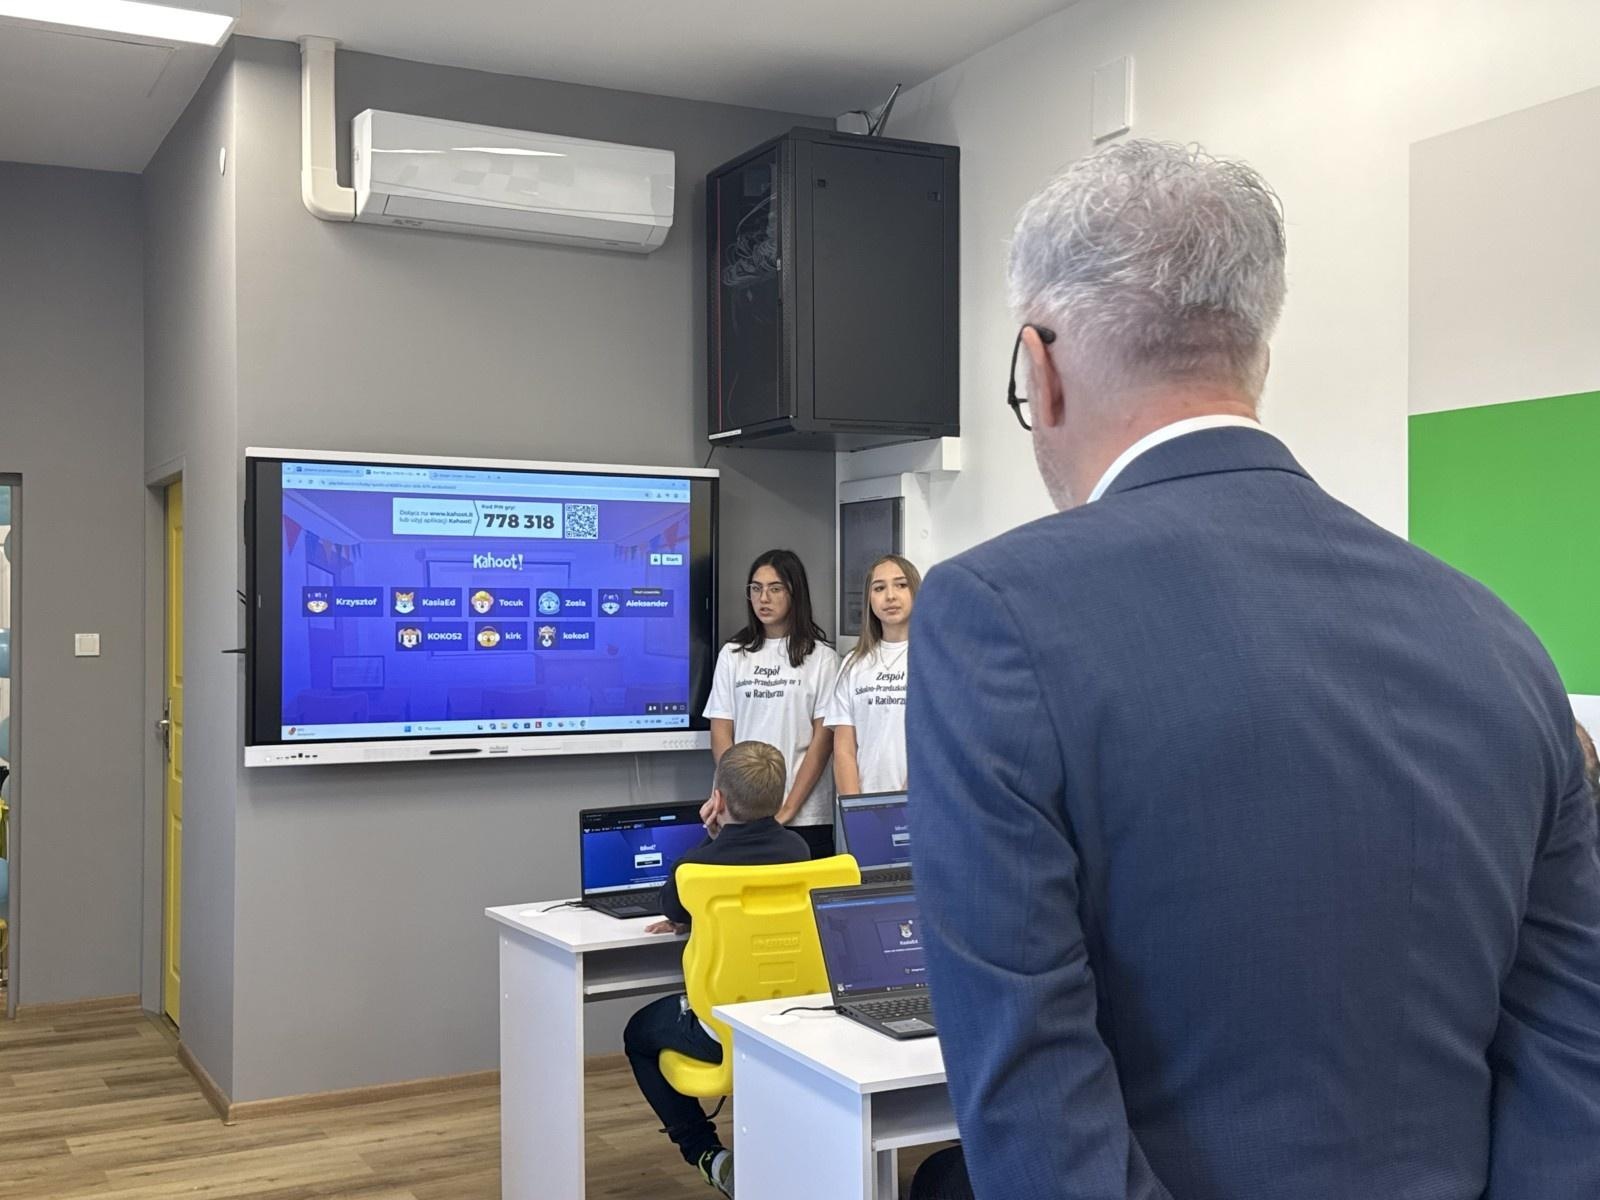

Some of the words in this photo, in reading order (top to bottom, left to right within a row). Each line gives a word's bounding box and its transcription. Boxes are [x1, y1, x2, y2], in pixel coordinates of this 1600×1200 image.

[483, 513, 520, 528] 778
[523, 514, 555, 529] 318
[472, 552, 524, 571] Kahoot!
[336, 598, 377, 607] Krzysztof
[422, 599, 456, 607] KasiaEd
[499, 599, 523, 607] Tocuk
[427, 632, 463, 640] KOKOS2
[505, 632, 521, 640] kirk
[753, 665, 781, 678] Zespół
[876, 671, 906, 683] Zespół
[753, 689, 785, 698] Raciborzu
